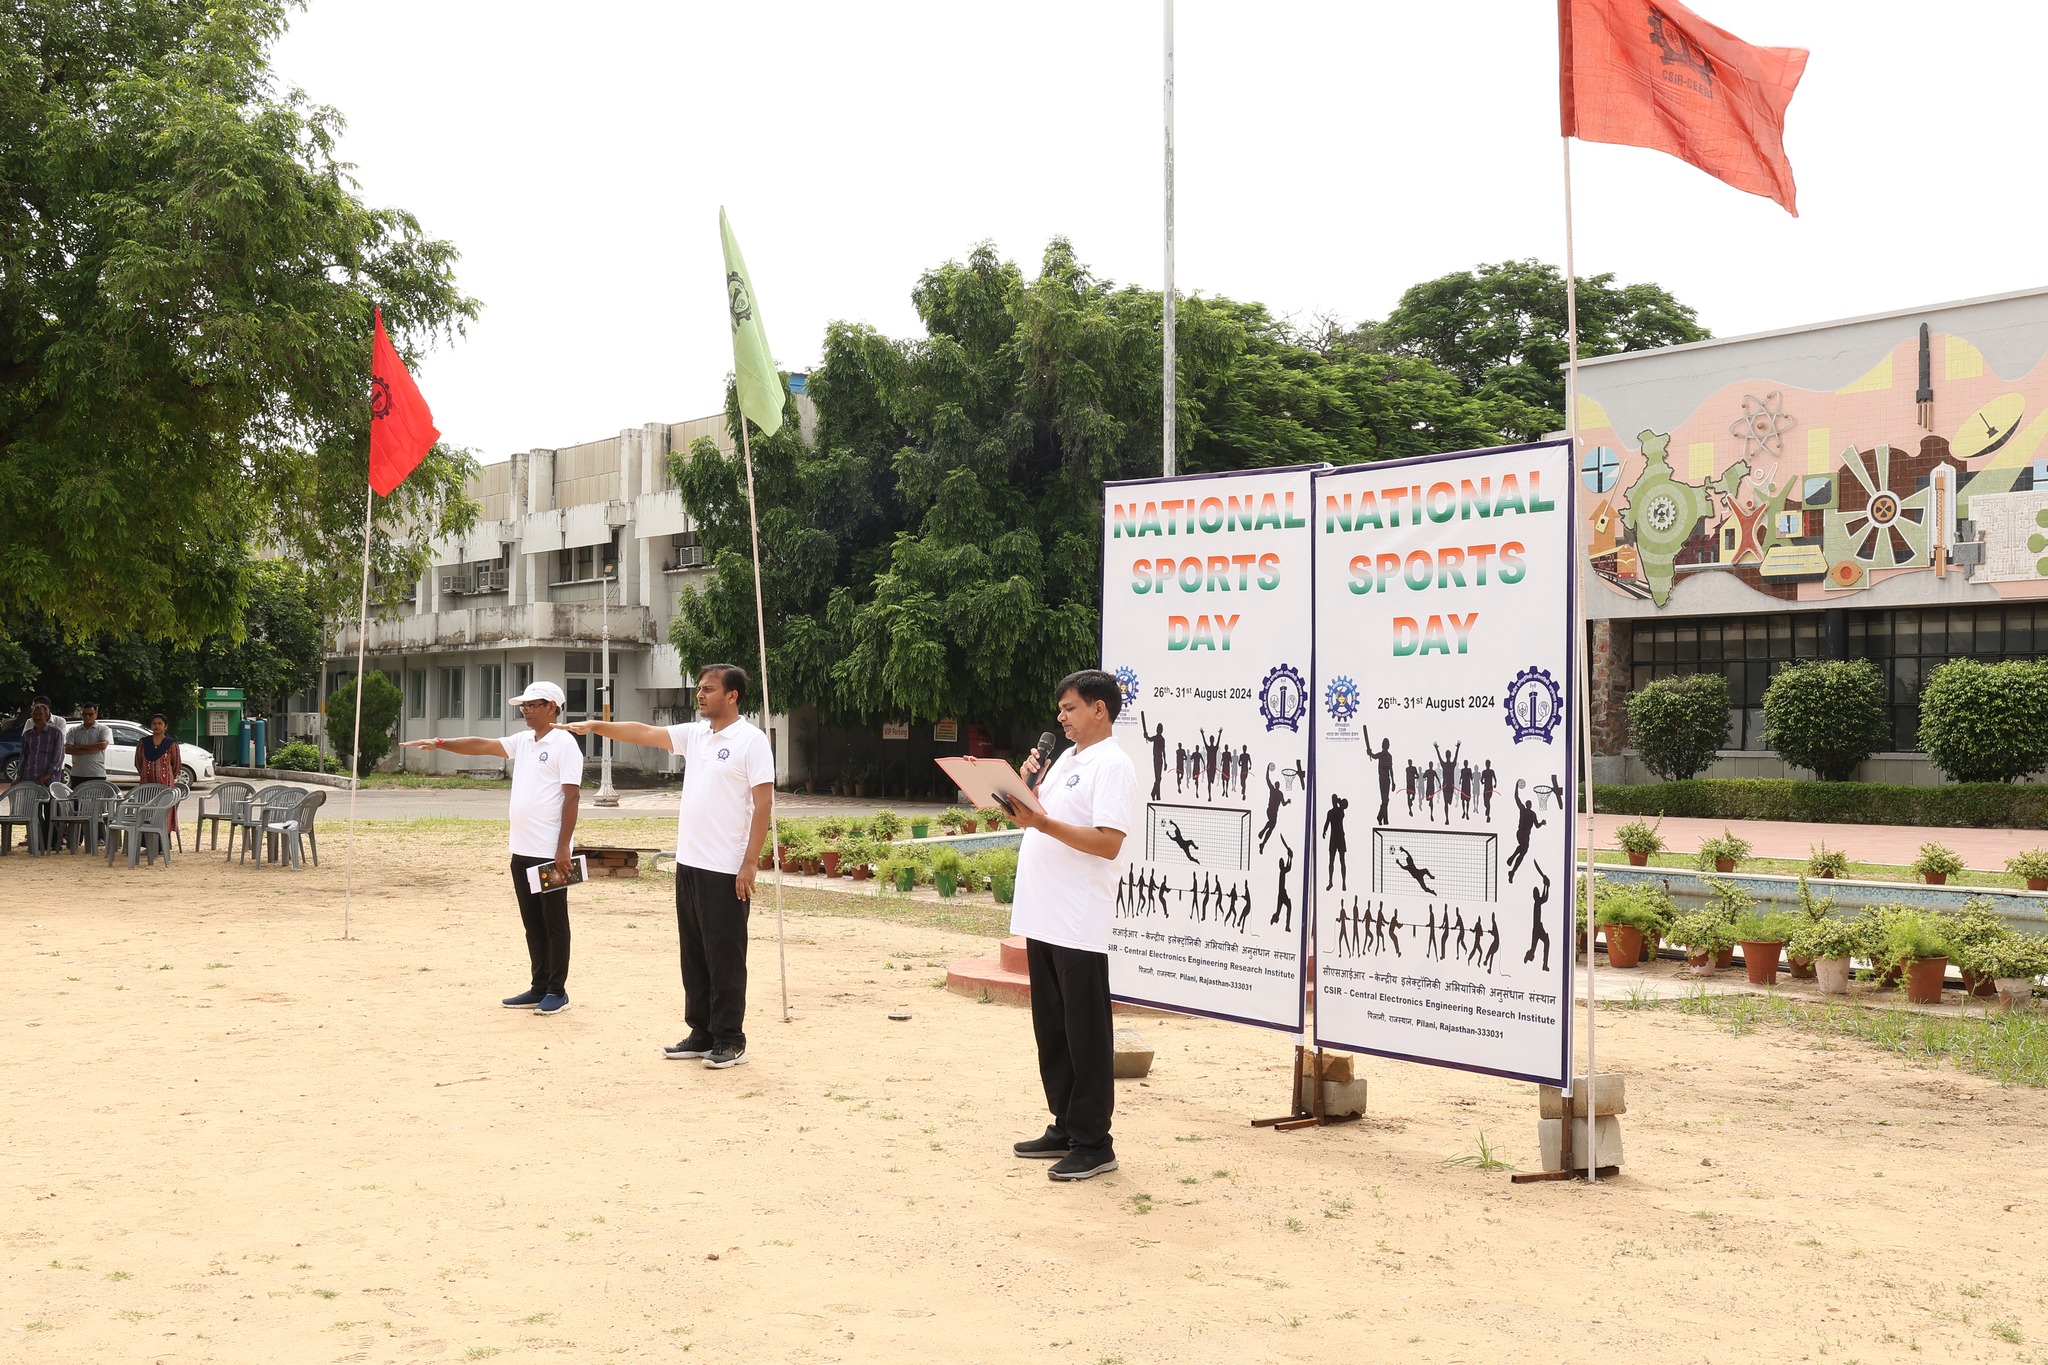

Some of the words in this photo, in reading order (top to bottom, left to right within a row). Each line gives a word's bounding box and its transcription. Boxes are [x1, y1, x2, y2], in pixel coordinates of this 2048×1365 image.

[1662, 69, 1713, 99] CSIR-CEERI
[1112, 491, 1307, 539] NATIONAL
[1325, 470, 1556, 535] NATIONAL
[1130, 552, 1282, 595] SPORTS
[1347, 540, 1527, 596] SPORTS
[1167, 614, 1241, 652] DAY
[1392, 612, 1479, 657] DAY
[1175, 686, 1193, 698] 31st
[1193, 687, 1227, 701] August
[1229, 688, 1252, 699] 2024
[1403, 696, 1424, 709] 31st
[1425, 696, 1466, 712] August
[1468, 695, 1496, 709] 2024
[1107, 943, 1118, 952] SIR
[1124, 946, 1148, 957] Central
[1149, 949, 1186, 963] Electronics
[1187, 955, 1228, 970] Engineering
[1229, 962, 1263, 974] Research
[1264, 967, 1295, 980] Institute
[1241, 945, 1271, 960] अनुसंधान
[1273, 948, 1296, 962] संस्थान
[1179, 973, 1198, 983] Pilani,
[1199, 976, 1253, 991] Rajasthan-333031
[1322, 965, 1366, 981] सीएसआईआर
[1489, 986, 1525, 1003] अनुसंधान
[1528, 989, 1557, 1005] संस्थान
[1323, 985, 1342, 995] CSIR
[1349, 989, 1378, 1001] Central
[1379, 993, 1424, 1007] Electronics
[1425, 999, 1474, 1015] Engineering
[1476, 1006, 1516, 1019] Research
[1518, 1011, 1556, 1025] Institute
[1416, 1019, 1438, 1030] Pilani,
[1439, 1022, 1504, 1039] Rajasthan-333031
